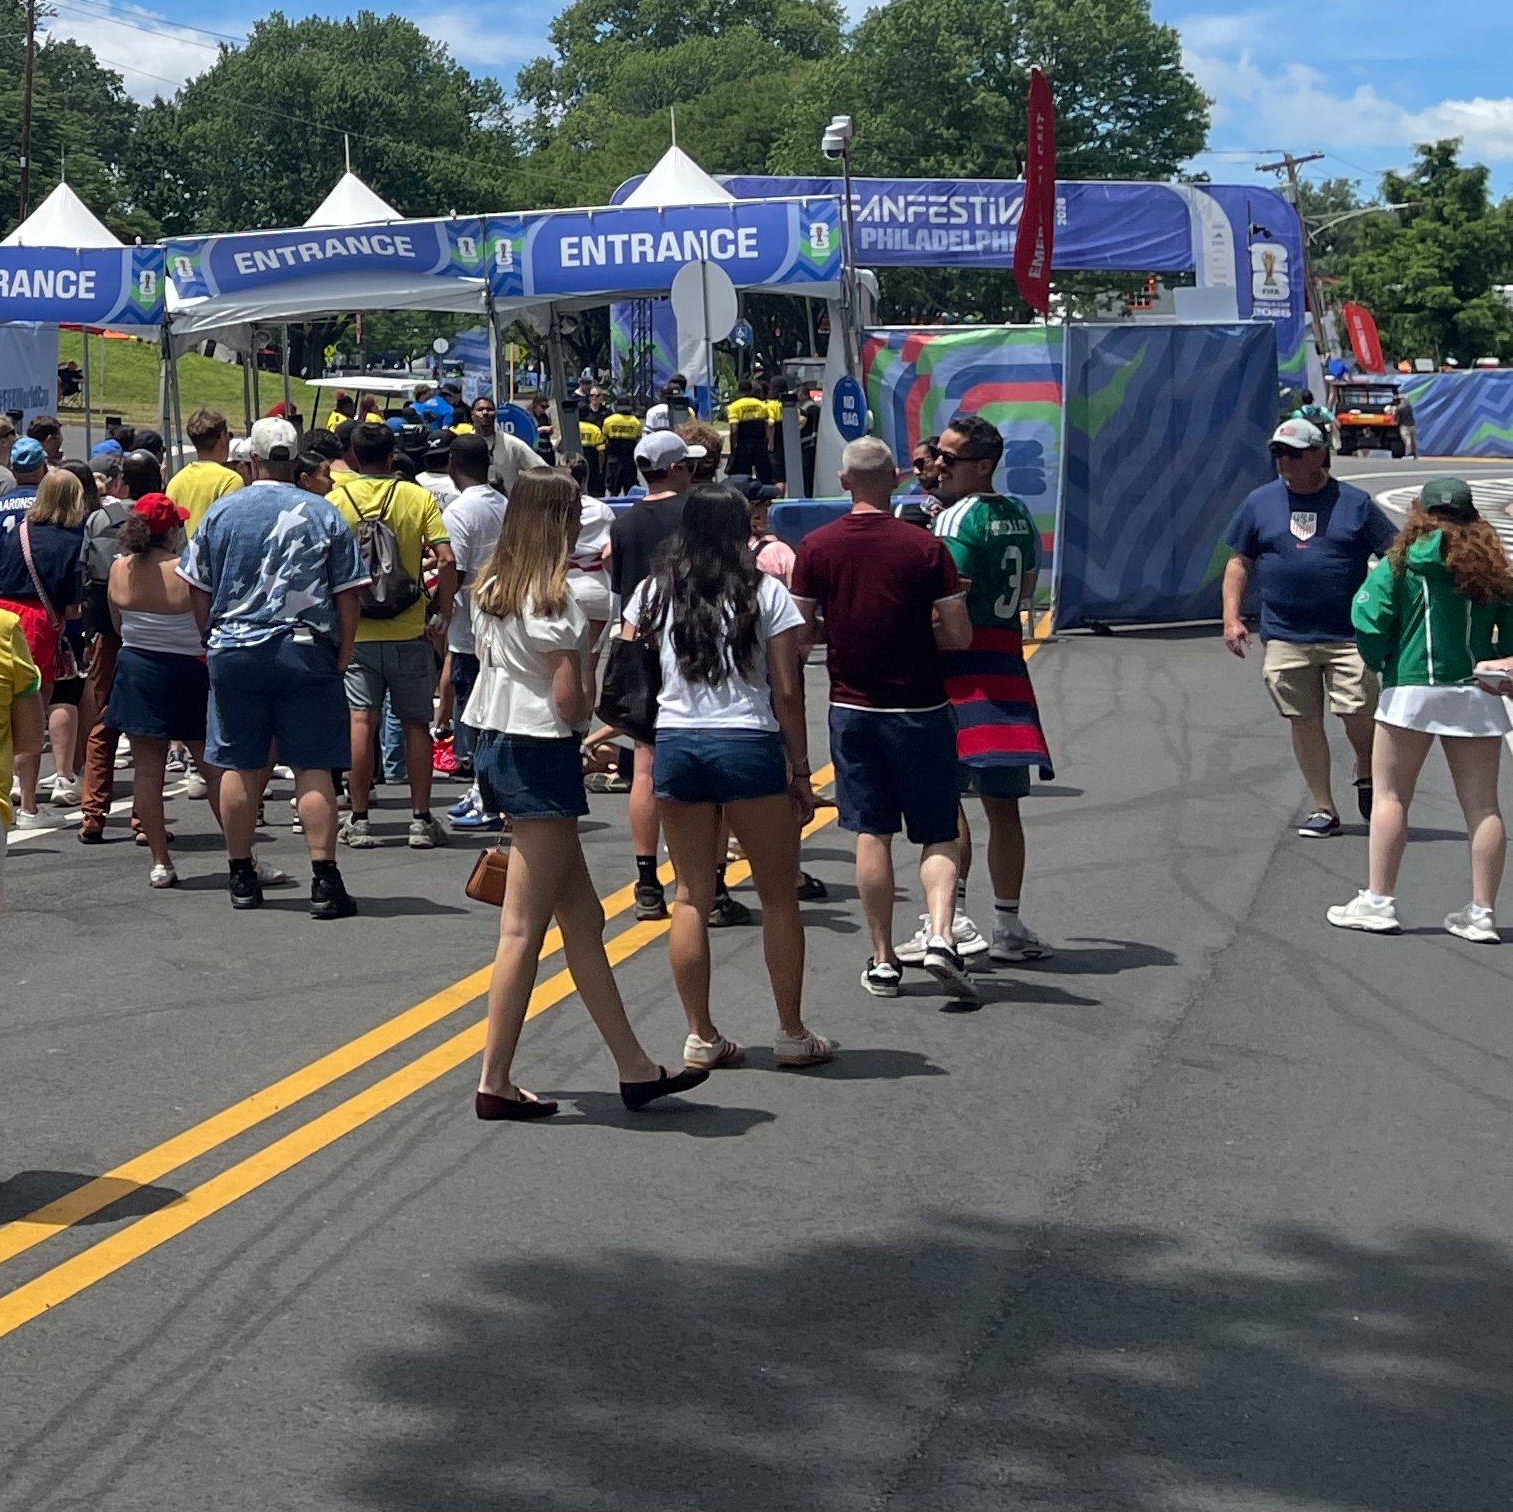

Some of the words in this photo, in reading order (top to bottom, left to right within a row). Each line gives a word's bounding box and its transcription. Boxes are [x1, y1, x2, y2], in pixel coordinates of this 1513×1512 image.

[234, 235, 416, 275] ENTRANCE
[560, 227, 758, 267] ENTRANCE
[861, 227, 1018, 252] PHILADELPHI
[843, 395, 855, 409] NO
[842, 411, 859, 426] BAG
[994, 545, 1023, 619] 3
